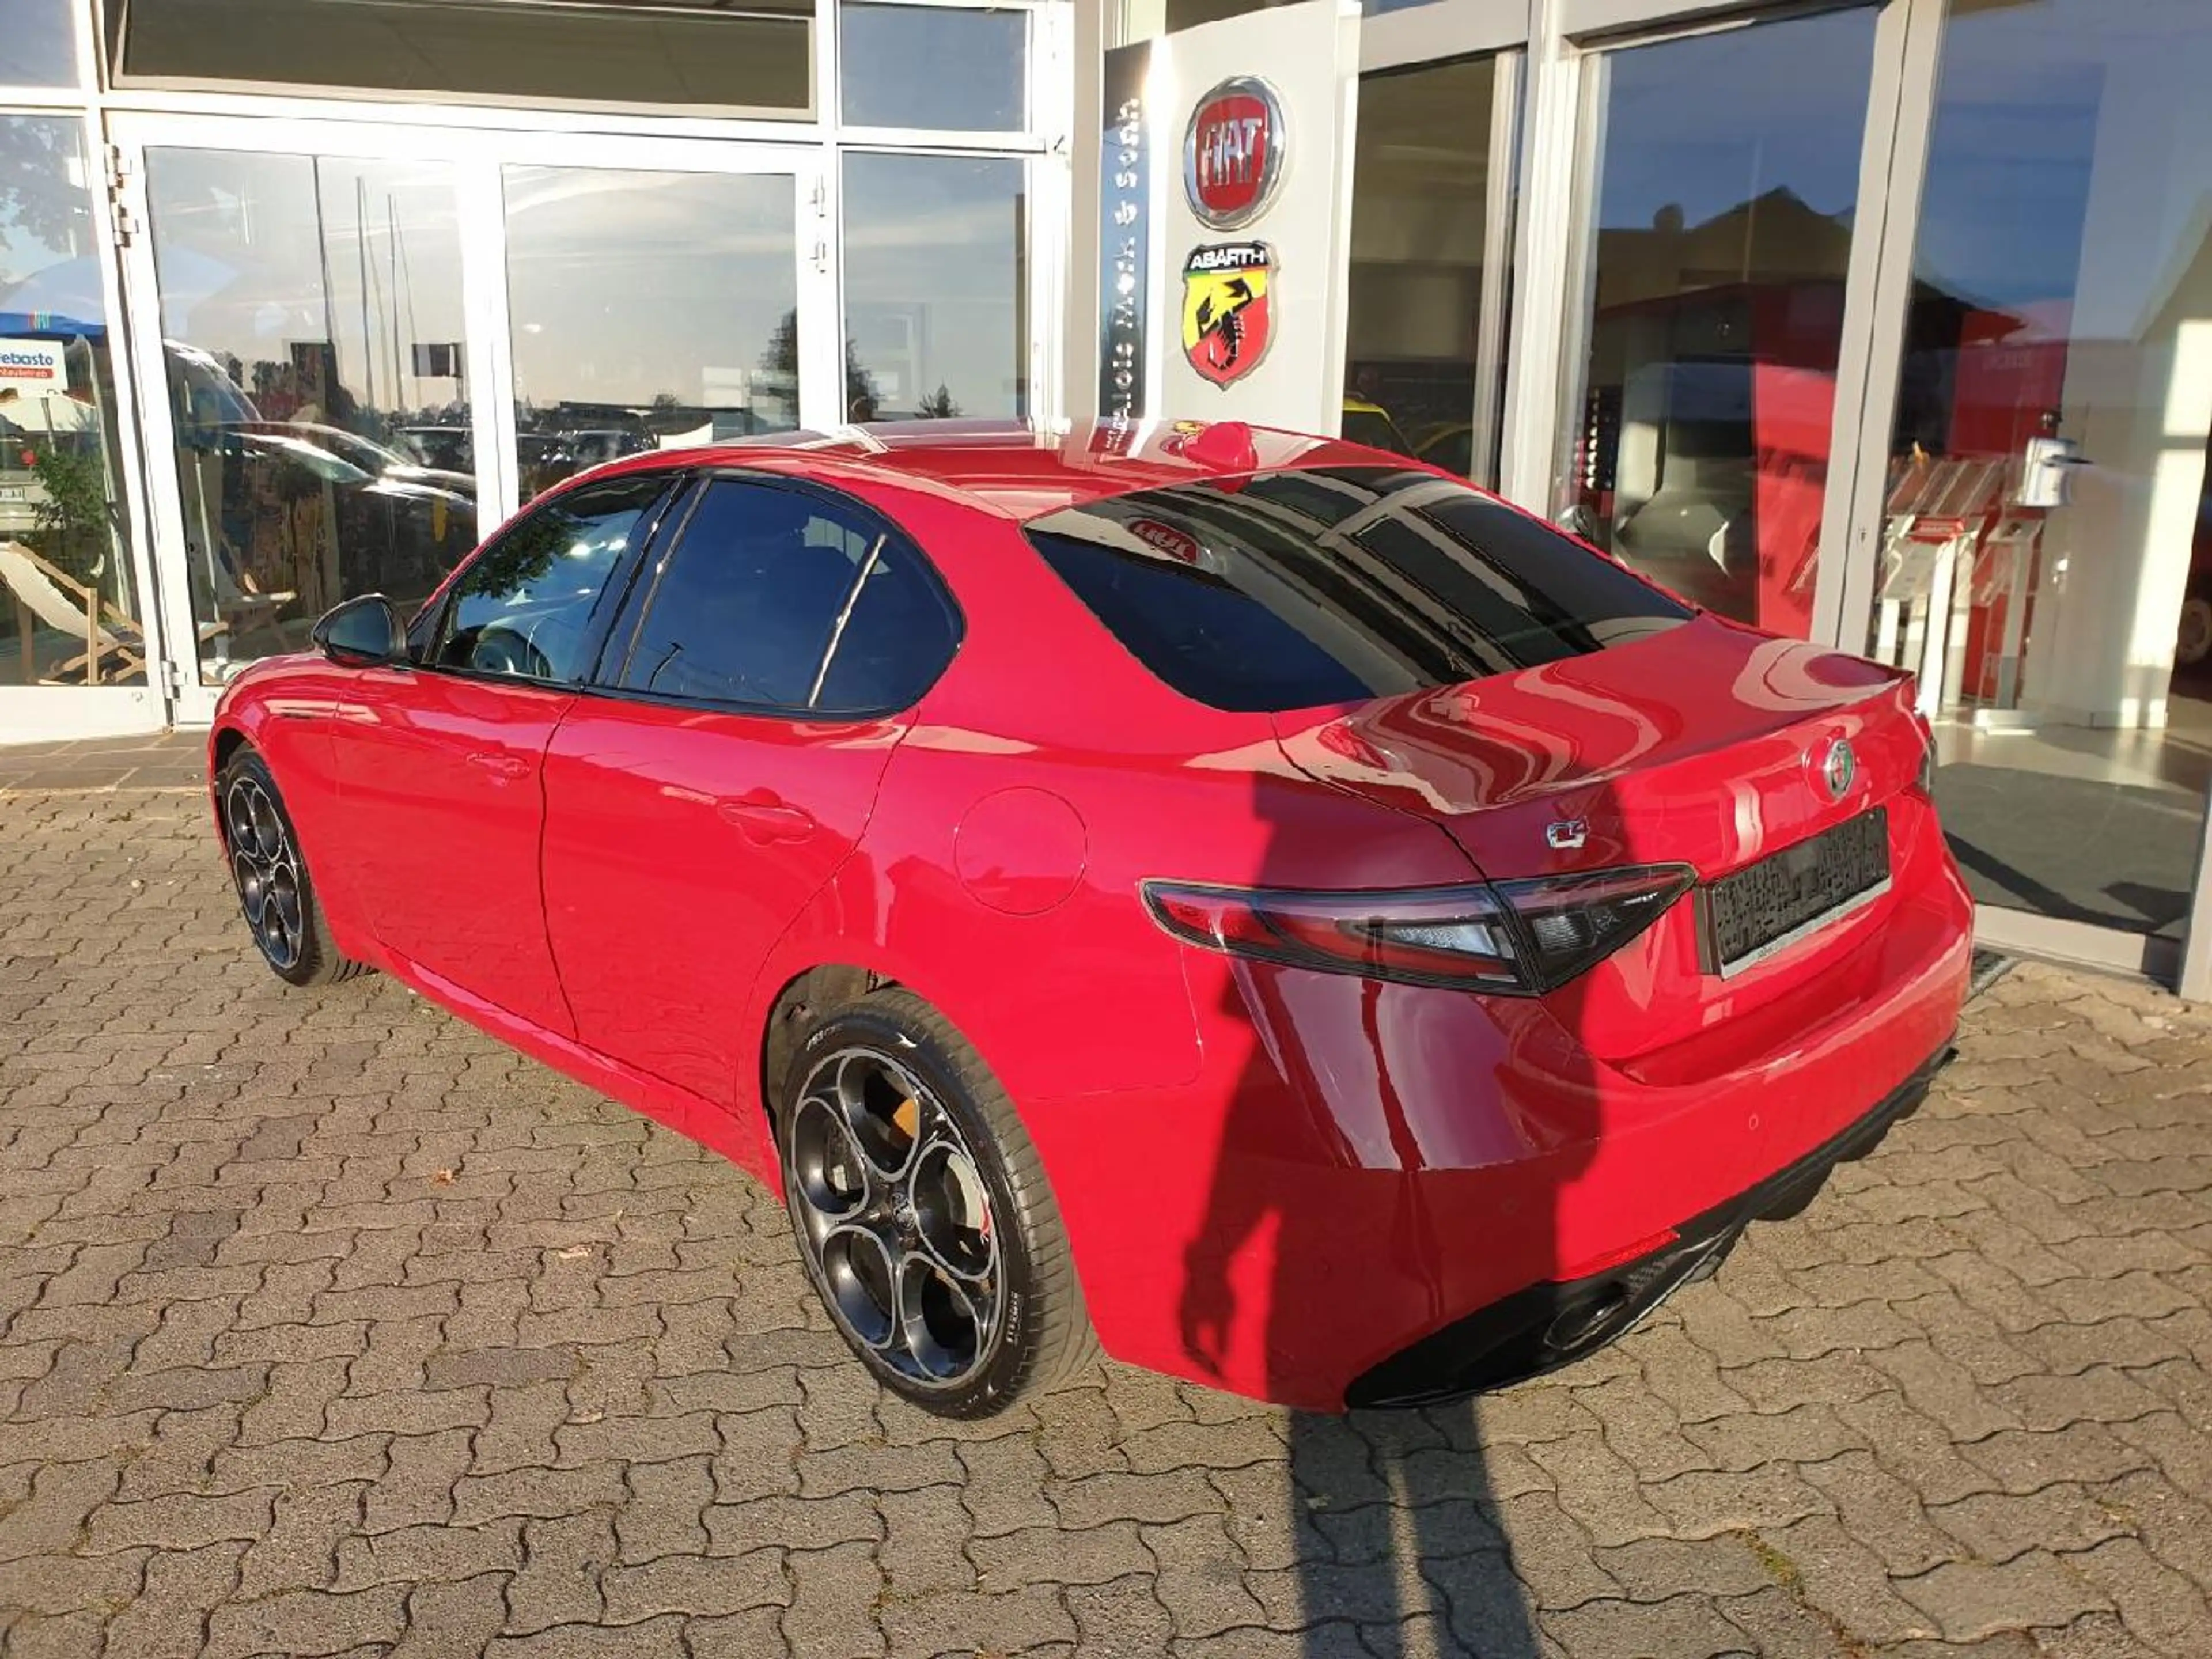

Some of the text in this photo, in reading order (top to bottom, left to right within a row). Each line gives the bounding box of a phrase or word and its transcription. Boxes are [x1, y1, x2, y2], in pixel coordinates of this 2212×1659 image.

[1201, 118, 1262, 187] FIAT
[1113, 200, 1137, 226] &
[1190, 248, 1264, 269] ABARTH
[0, 353, 54, 366] ebasto
